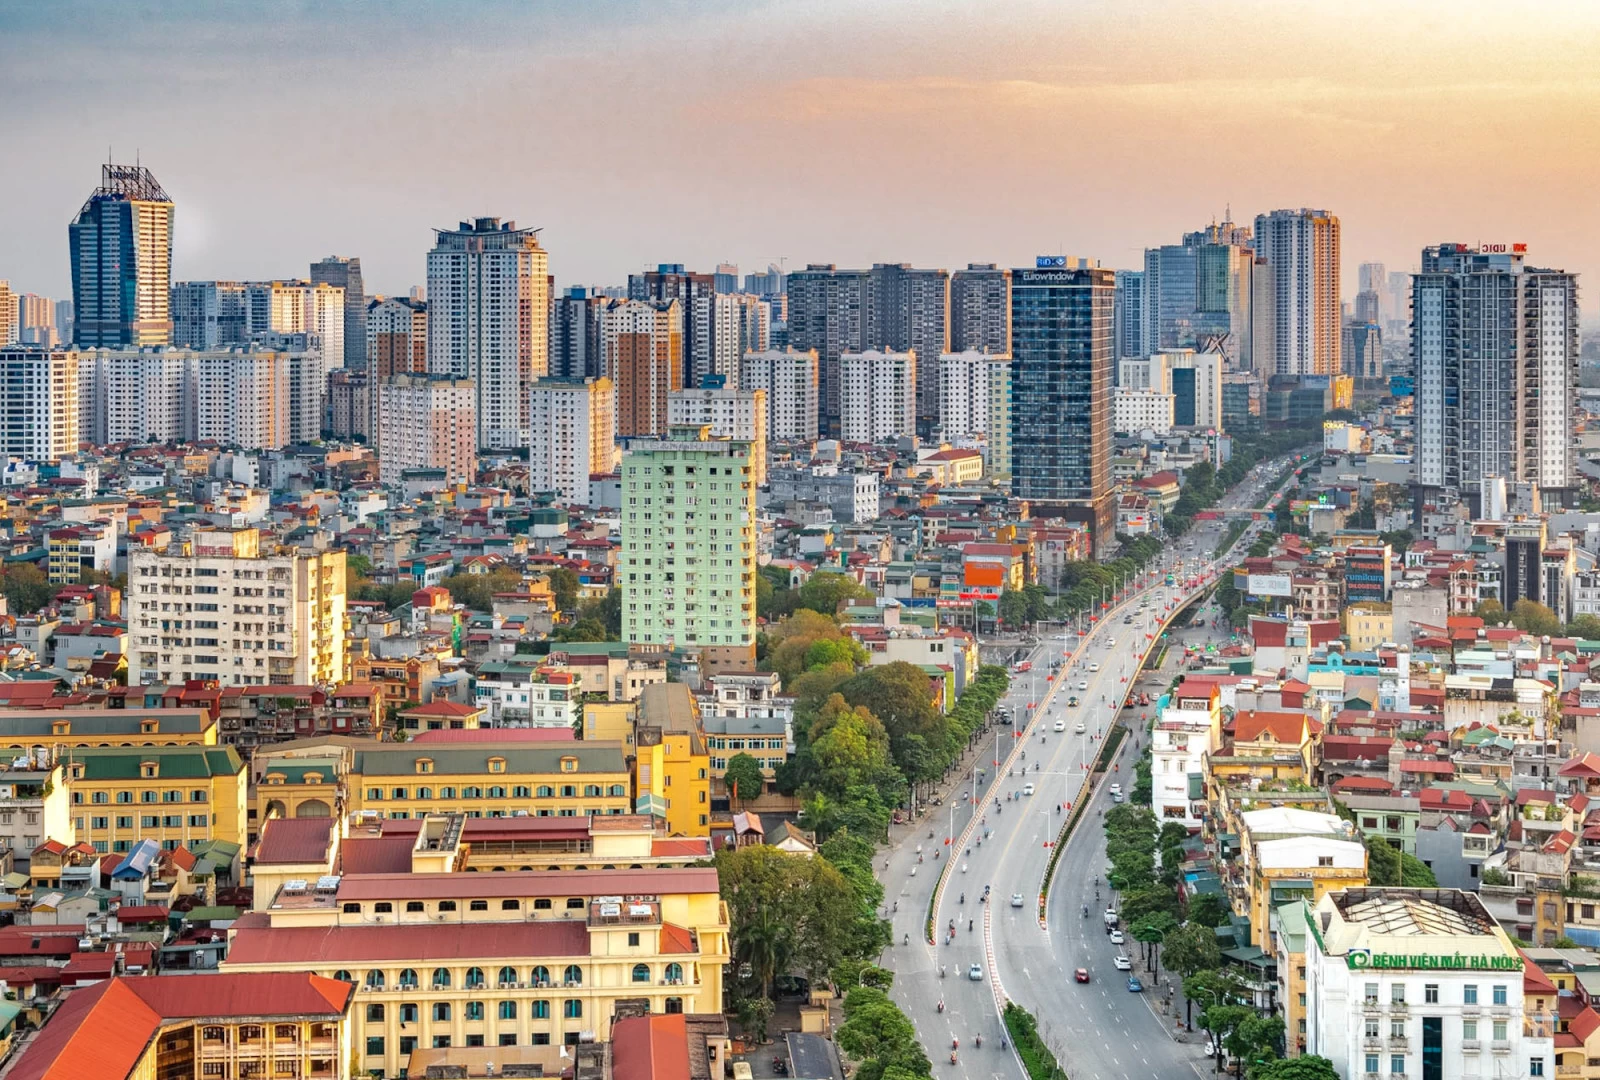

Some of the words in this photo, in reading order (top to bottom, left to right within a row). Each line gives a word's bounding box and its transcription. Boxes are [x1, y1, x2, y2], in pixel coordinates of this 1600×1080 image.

[1023, 271, 1075, 281] Eurowindow
[1373, 952, 1407, 969] BỆNH
[1410, 952, 1438, 969] VIỆN
[1441, 951, 1468, 968] MẮT
[1471, 953, 1488, 968] HÀ
